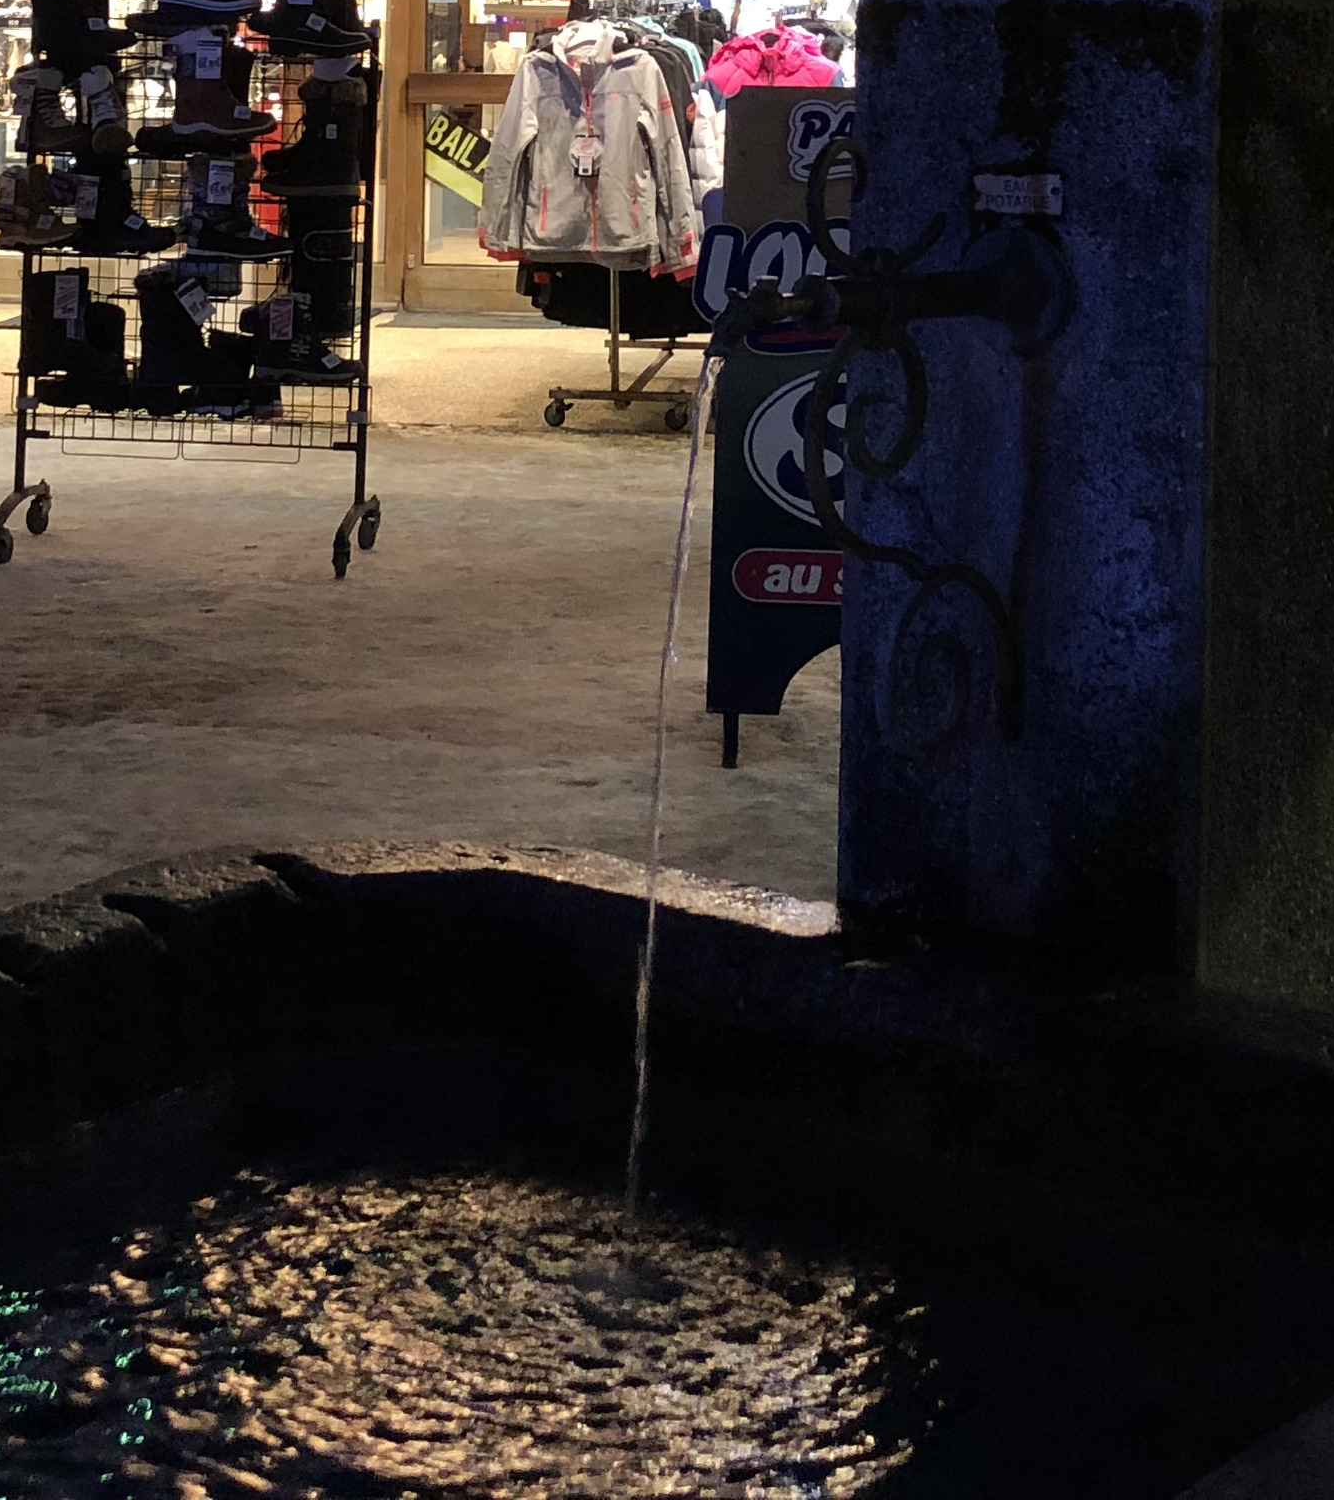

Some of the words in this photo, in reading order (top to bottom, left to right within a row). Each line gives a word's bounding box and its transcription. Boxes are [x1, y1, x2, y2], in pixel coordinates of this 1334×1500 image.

[426, 115, 479, 168] BAIL
[1003, 180, 1030, 192] EAU
[986, 195, 1051, 210] POTABLE
[763, 564, 823, 594] au
